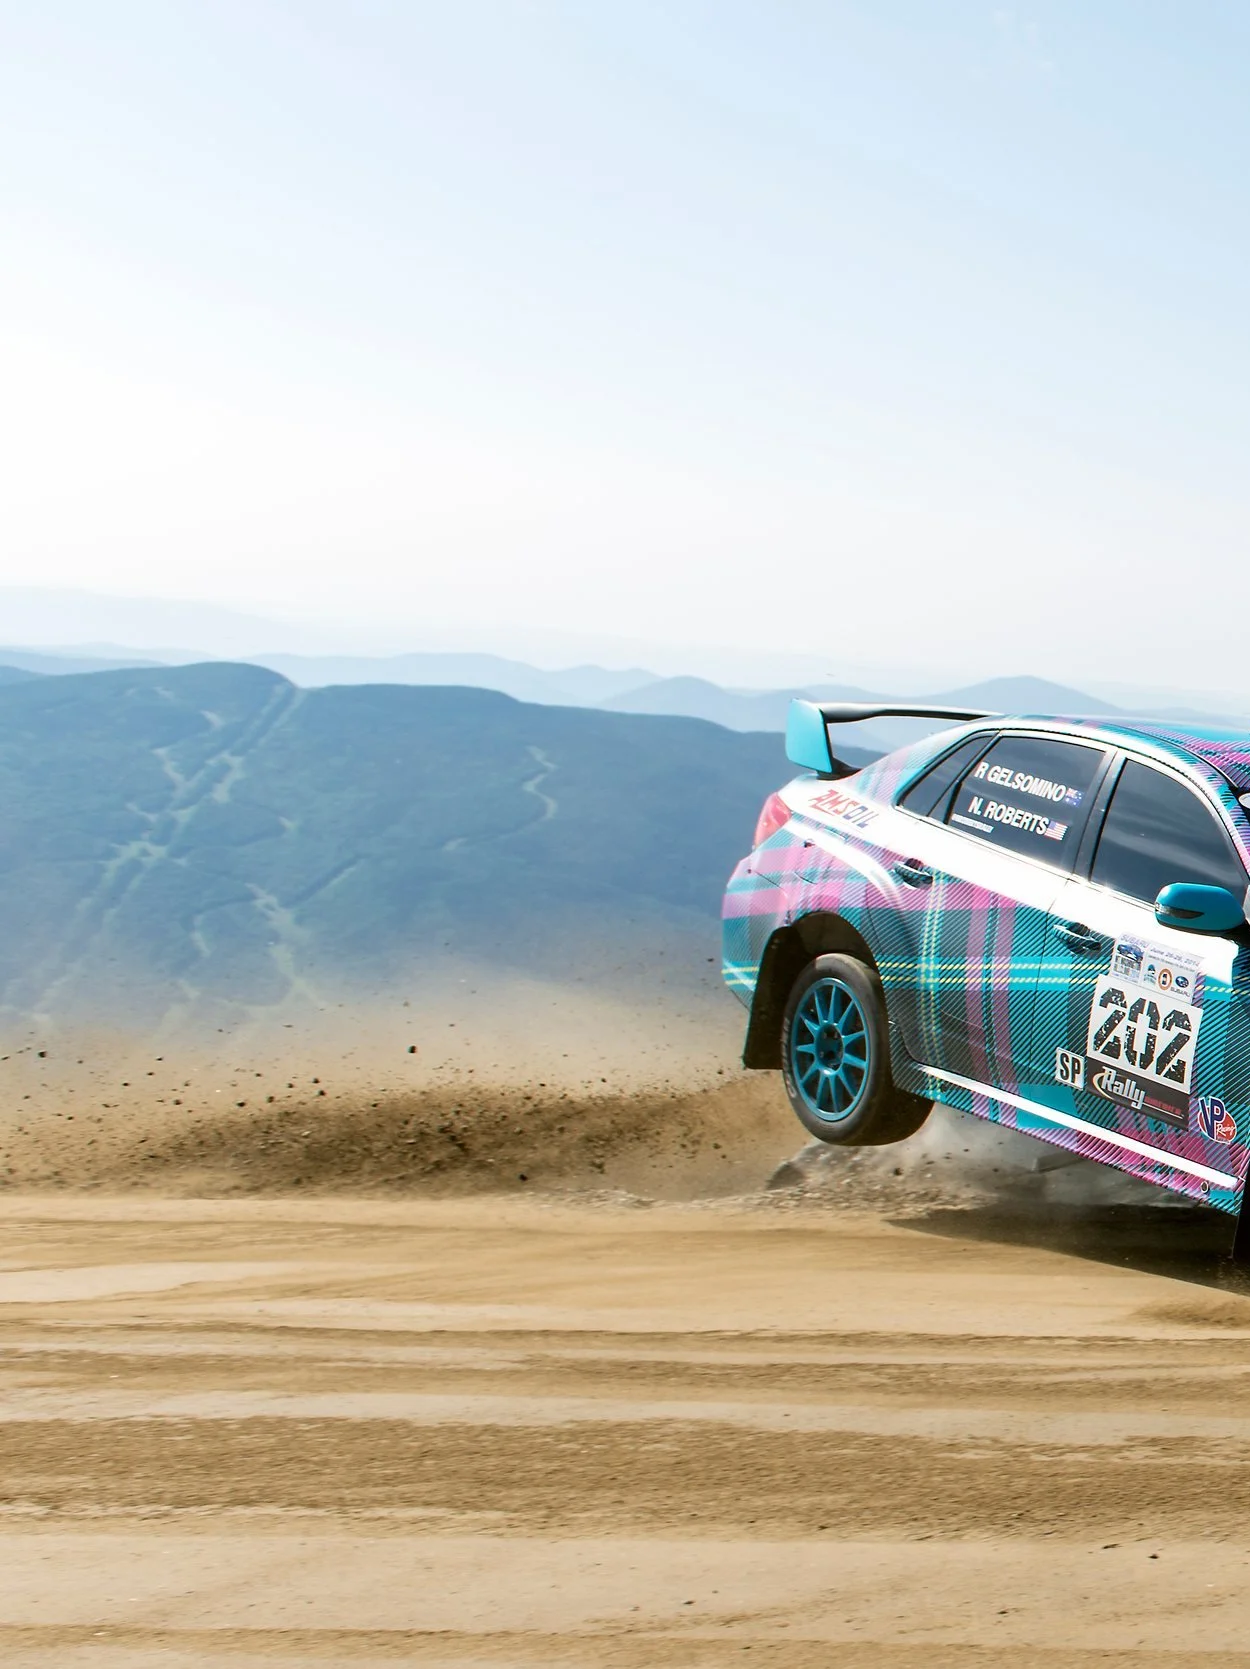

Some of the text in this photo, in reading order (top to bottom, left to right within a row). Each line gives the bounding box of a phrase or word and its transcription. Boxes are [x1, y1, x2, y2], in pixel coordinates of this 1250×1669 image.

[974, 762, 1066, 802] R GELSOMINO
[808, 789, 879, 828] AMSOIL
[968, 797, 982, 816] N.
[983, 801, 1049, 835] ROBERTS
[1121, 934, 1149, 948] SUBARU
[1093, 987, 1192, 1084] 202
[1060, 1053, 1081, 1083] SP
[1100, 1066, 1146, 1110] Rally
[1199, 1097, 1225, 1139] VP
